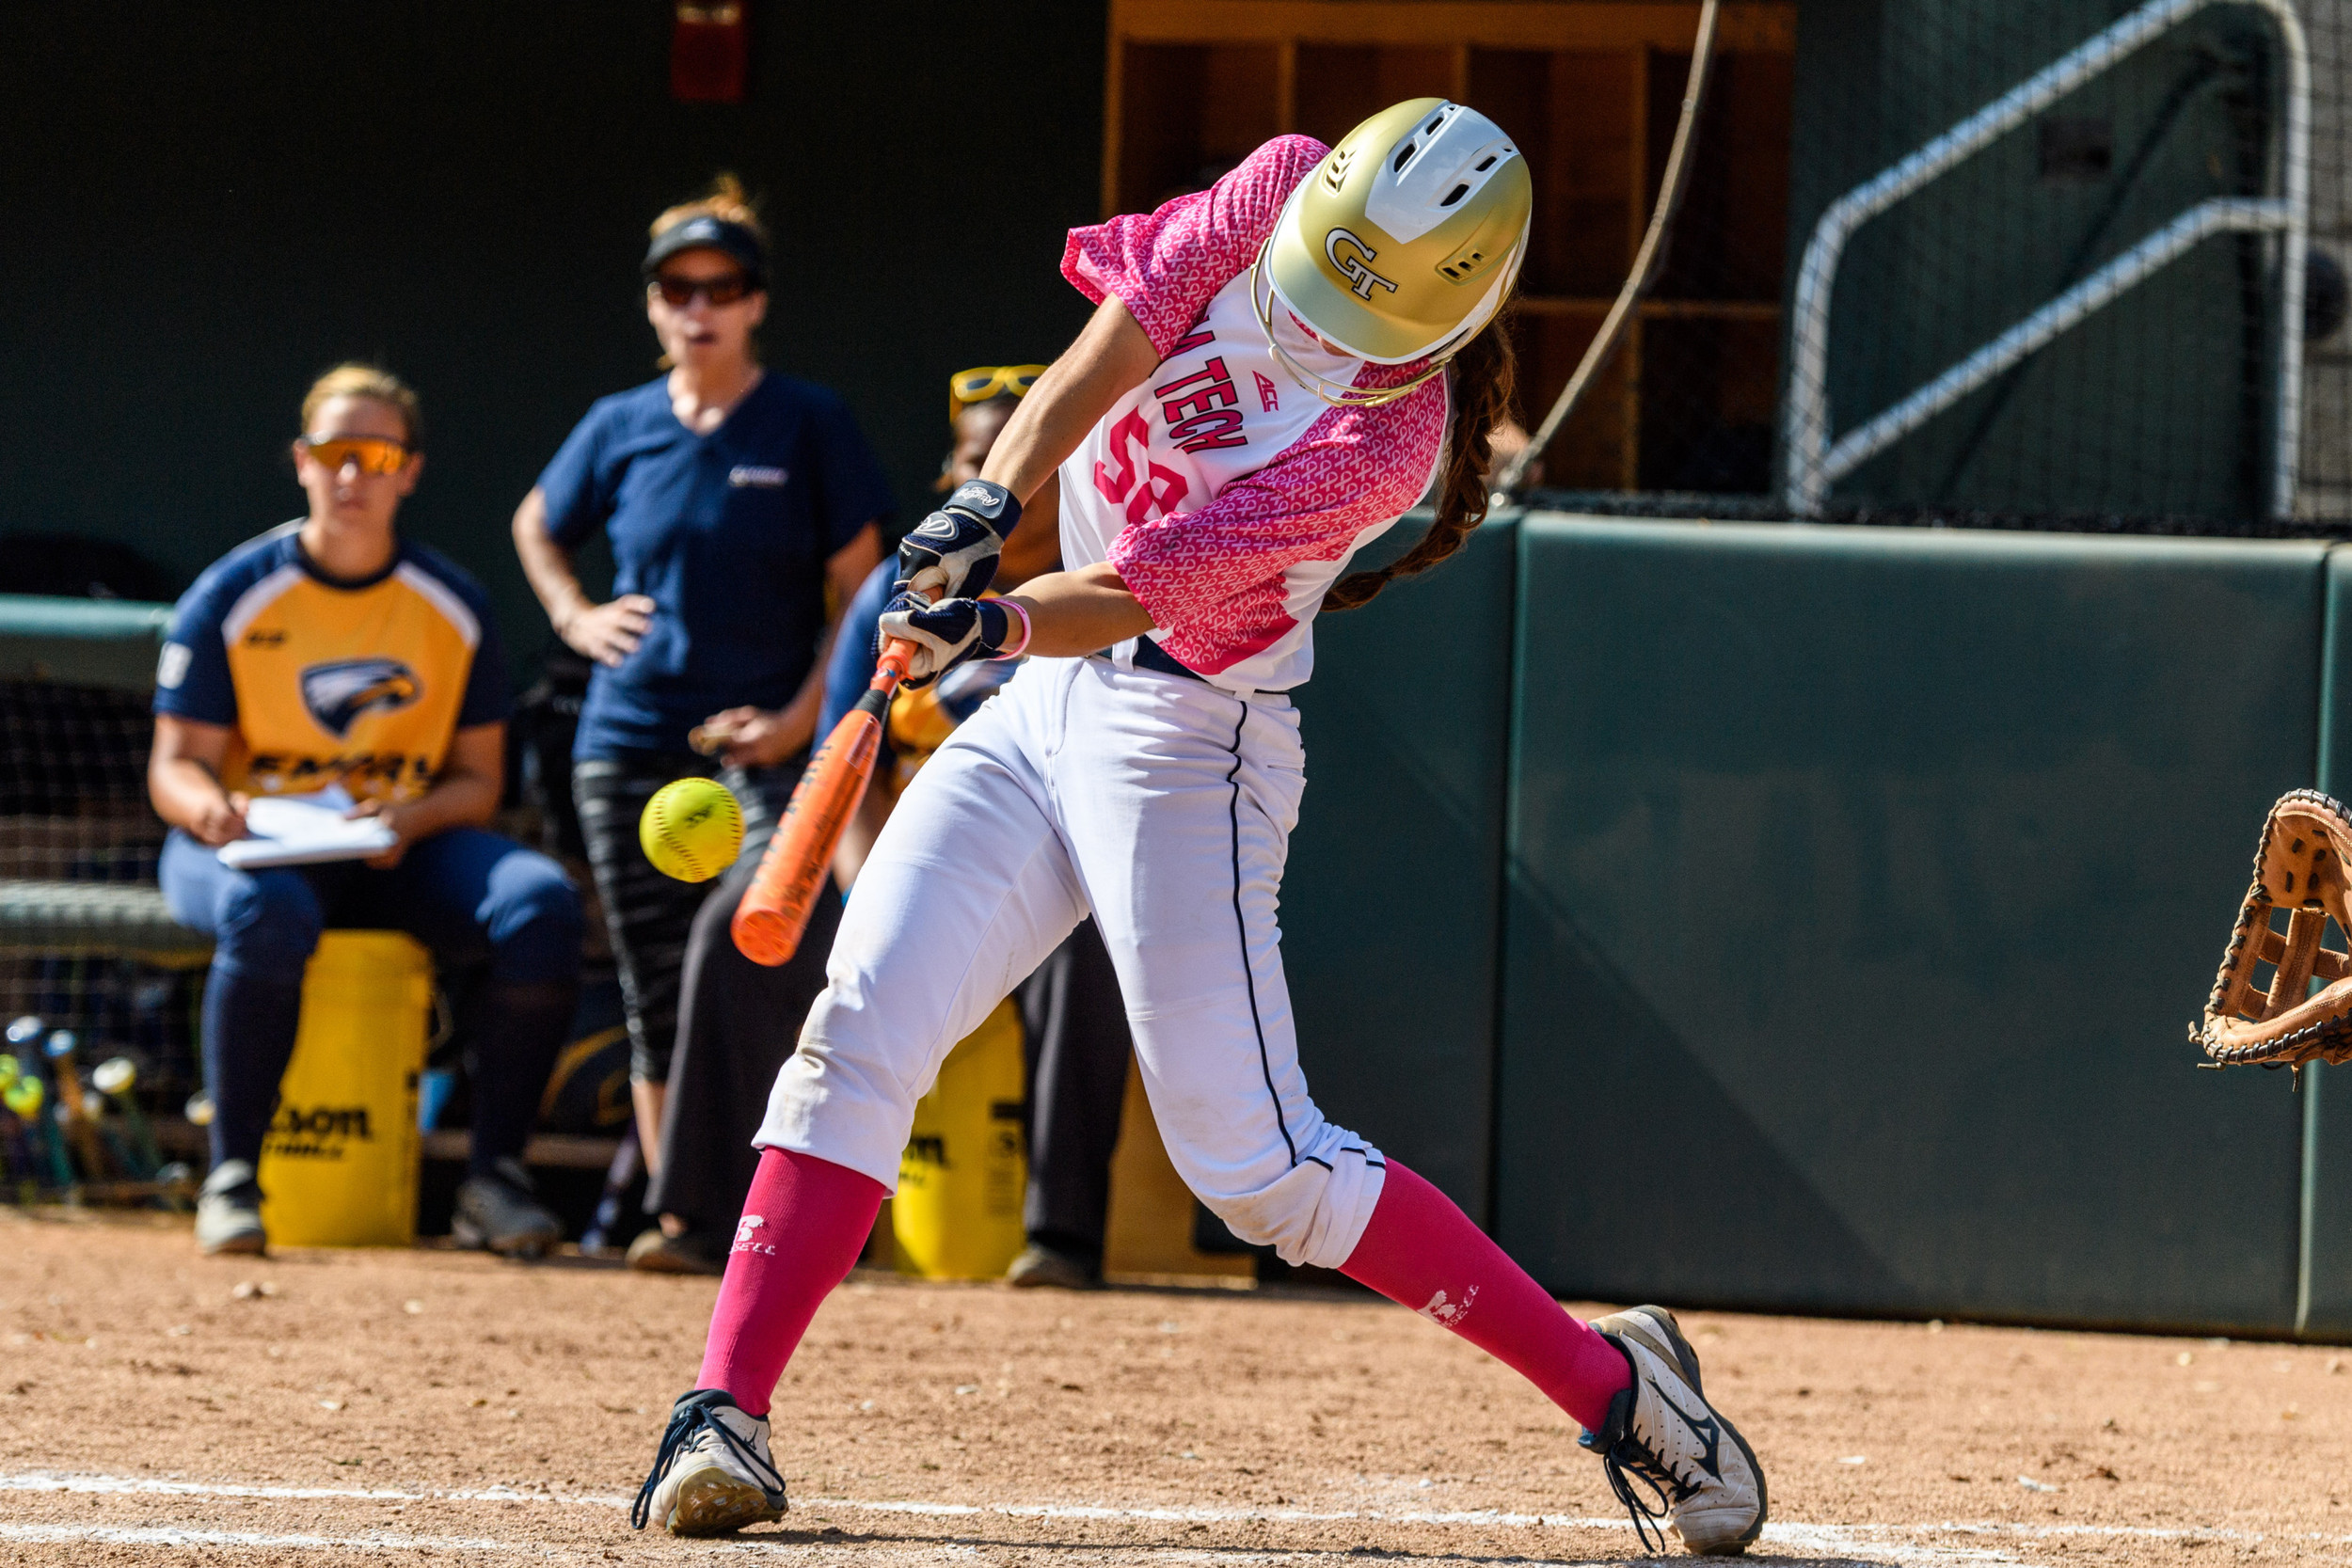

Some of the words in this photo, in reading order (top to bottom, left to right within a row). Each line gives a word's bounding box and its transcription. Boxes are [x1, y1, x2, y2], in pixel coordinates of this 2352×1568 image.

[1325, 228, 1399, 301] GT
[1153, 356, 1248, 455] TECH
[1252, 370, 1279, 413] ACC
